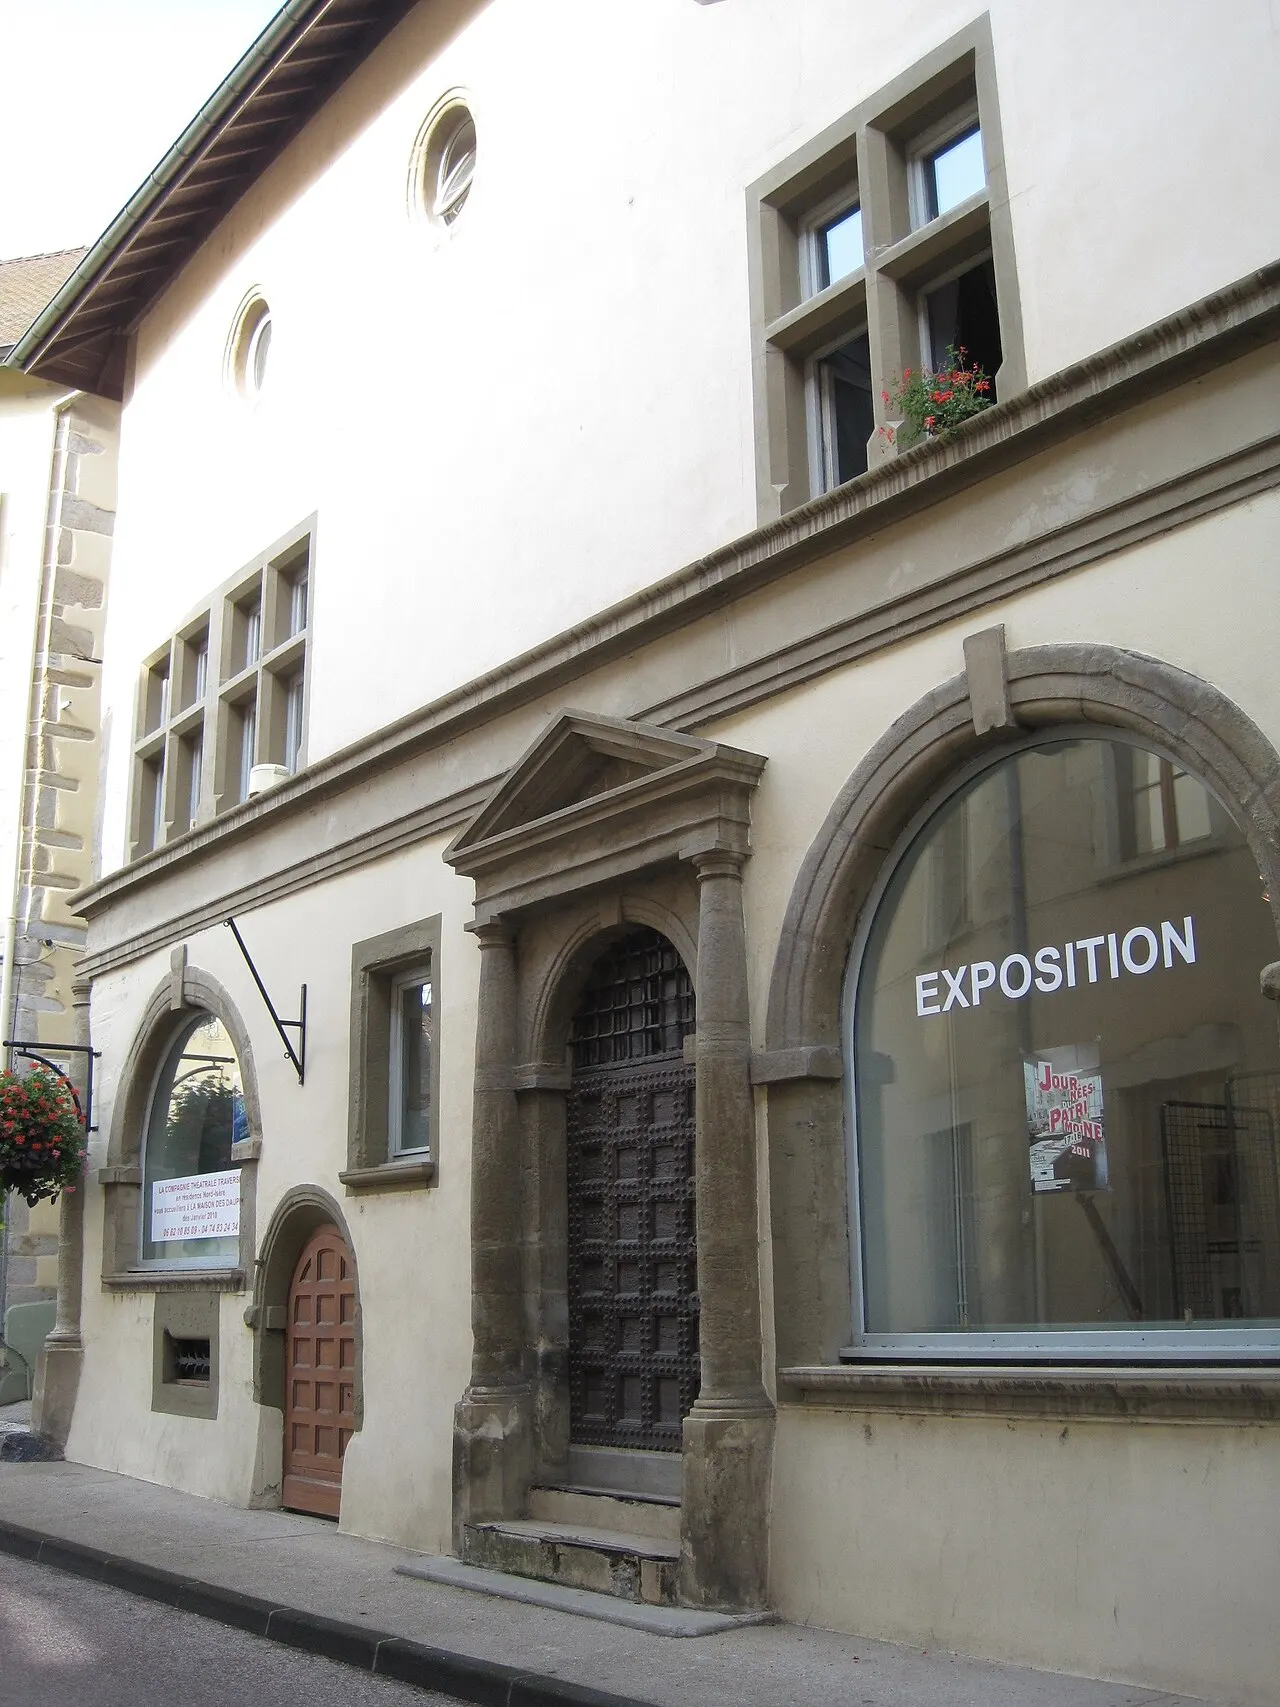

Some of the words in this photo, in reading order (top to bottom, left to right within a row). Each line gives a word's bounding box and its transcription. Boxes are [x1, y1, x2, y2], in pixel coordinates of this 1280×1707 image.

[915, 916, 1196, 1016] EXPOSITION
[1050, 1100, 1087, 1133] PATRI
[1065, 1121, 1102, 1142] MOINE
[1071, 1145, 1090, 1158] 2011
[158, 1186, 165, 1194] LA
[165, 1183, 190, 1193] COMPAGNIE
[197, 1200, 215, 1210] MAISON
[216, 1199, 225, 1208] DES
